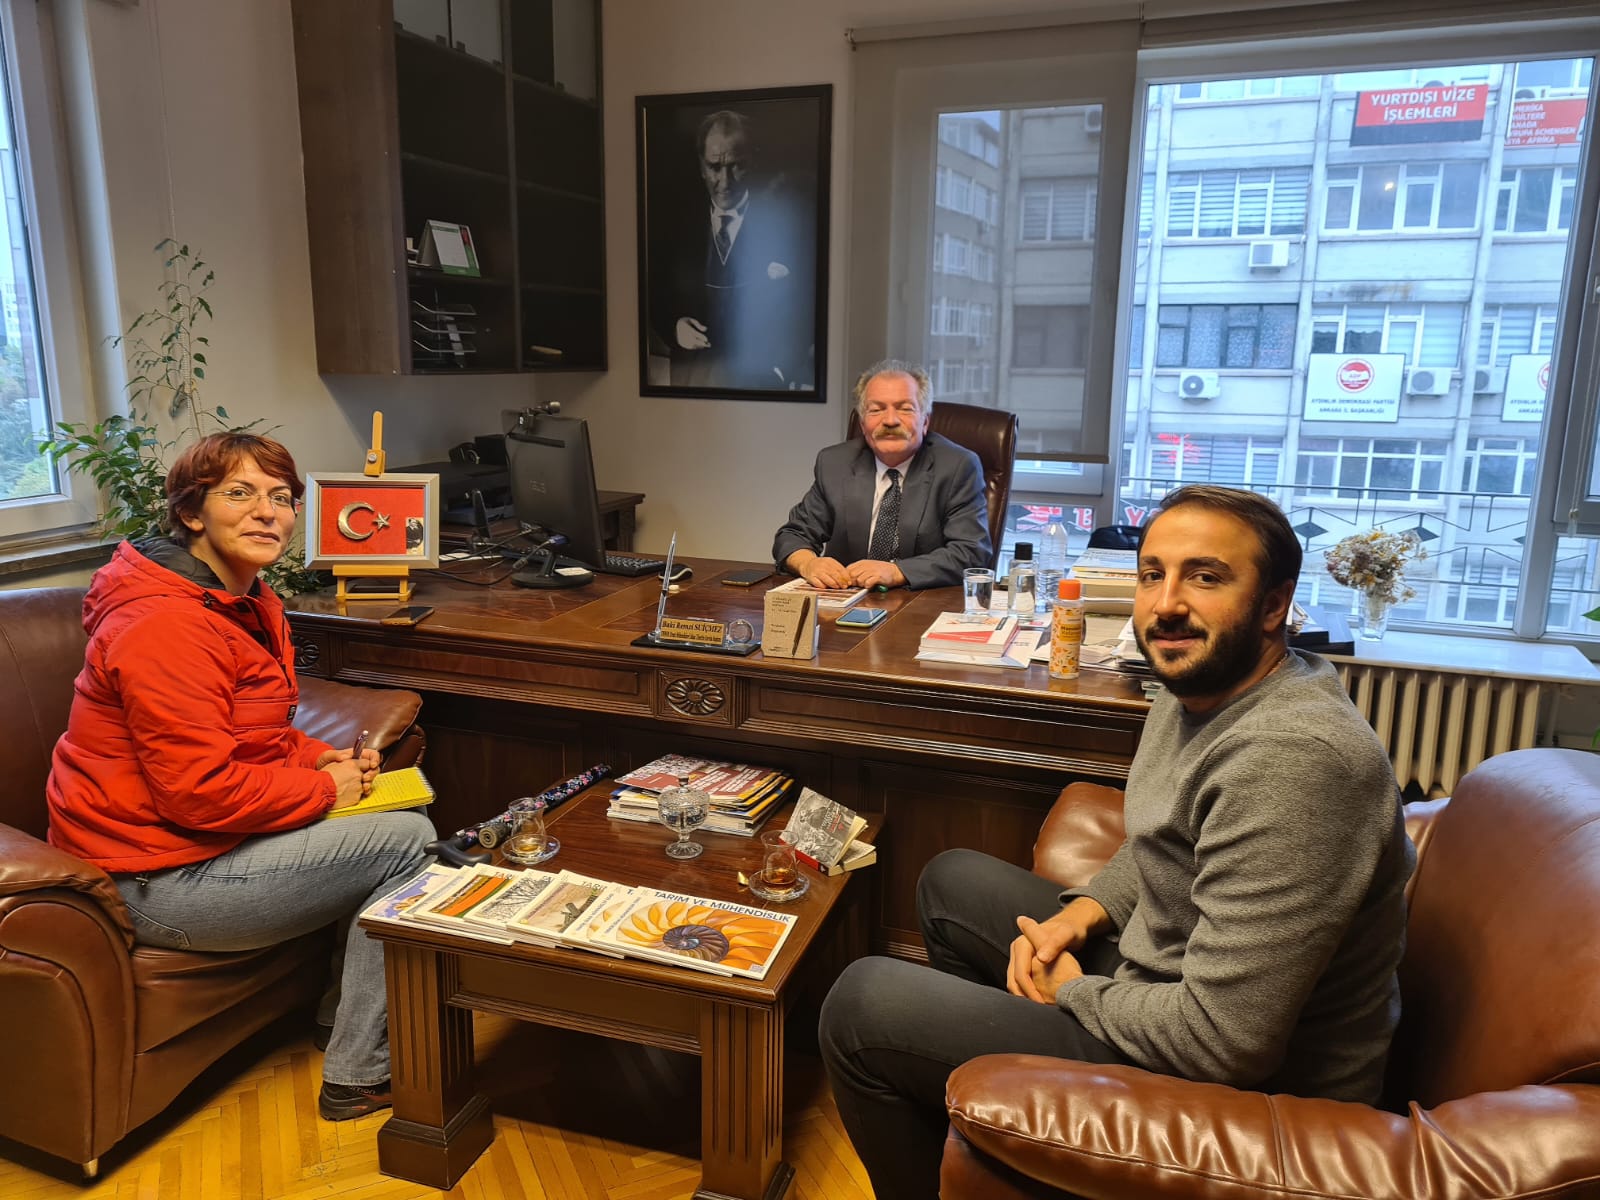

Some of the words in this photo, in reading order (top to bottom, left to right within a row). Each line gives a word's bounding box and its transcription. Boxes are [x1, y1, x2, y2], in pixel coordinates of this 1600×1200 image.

[1371, 90, 1438, 106] YURTDIŞI
[1442, 87, 1476, 102] VİZE
[1383, 103, 1458, 124] İŞLEMLERİ
[654, 891, 689, 903] TARIM
[693, 898, 707, 906] VE
